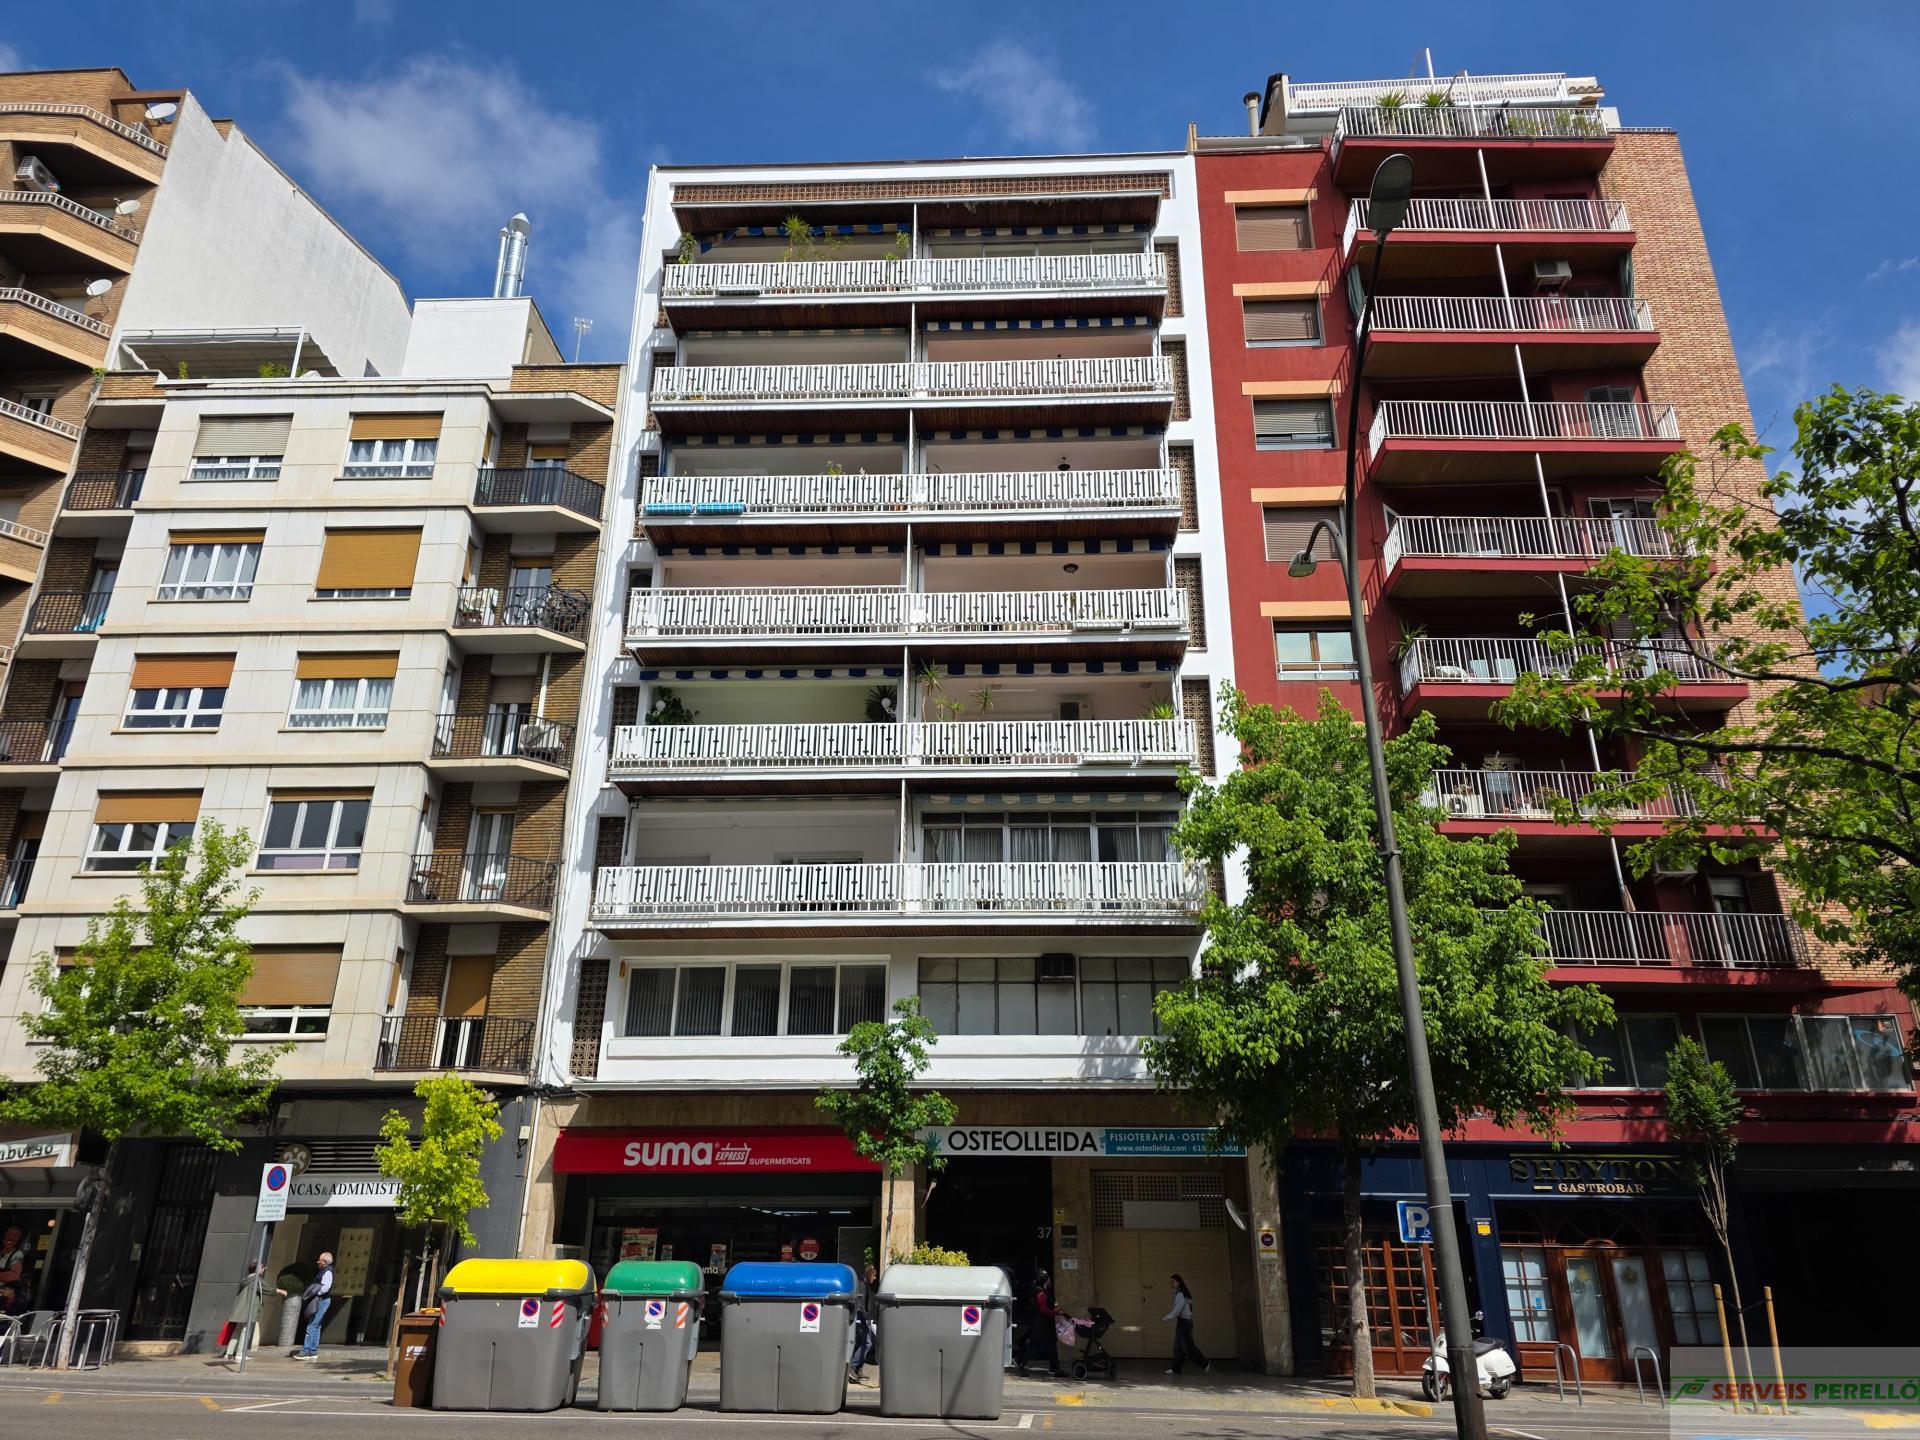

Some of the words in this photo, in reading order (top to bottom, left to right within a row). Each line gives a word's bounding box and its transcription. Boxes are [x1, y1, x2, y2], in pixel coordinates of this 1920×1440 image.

[948, 1130, 1098, 1151] OSTEOLLEIDA
[1110, 1131, 1176, 1142] FISIOTERÀPIA
[623, 1142, 712, 1166] suma
[1116, 1144, 1187, 1153] www.osteolleida.com
[715, 1151, 746, 1161] EXPRESS
[749, 1157, 812, 1165] SUPERMERCATS
[1509, 1158, 1686, 1182] SHEYTON
[1557, 1182, 1645, 1194] GASTROBAR
[1405, 1206, 1429, 1239] P
[1037, 1226, 1052, 1239] 37
